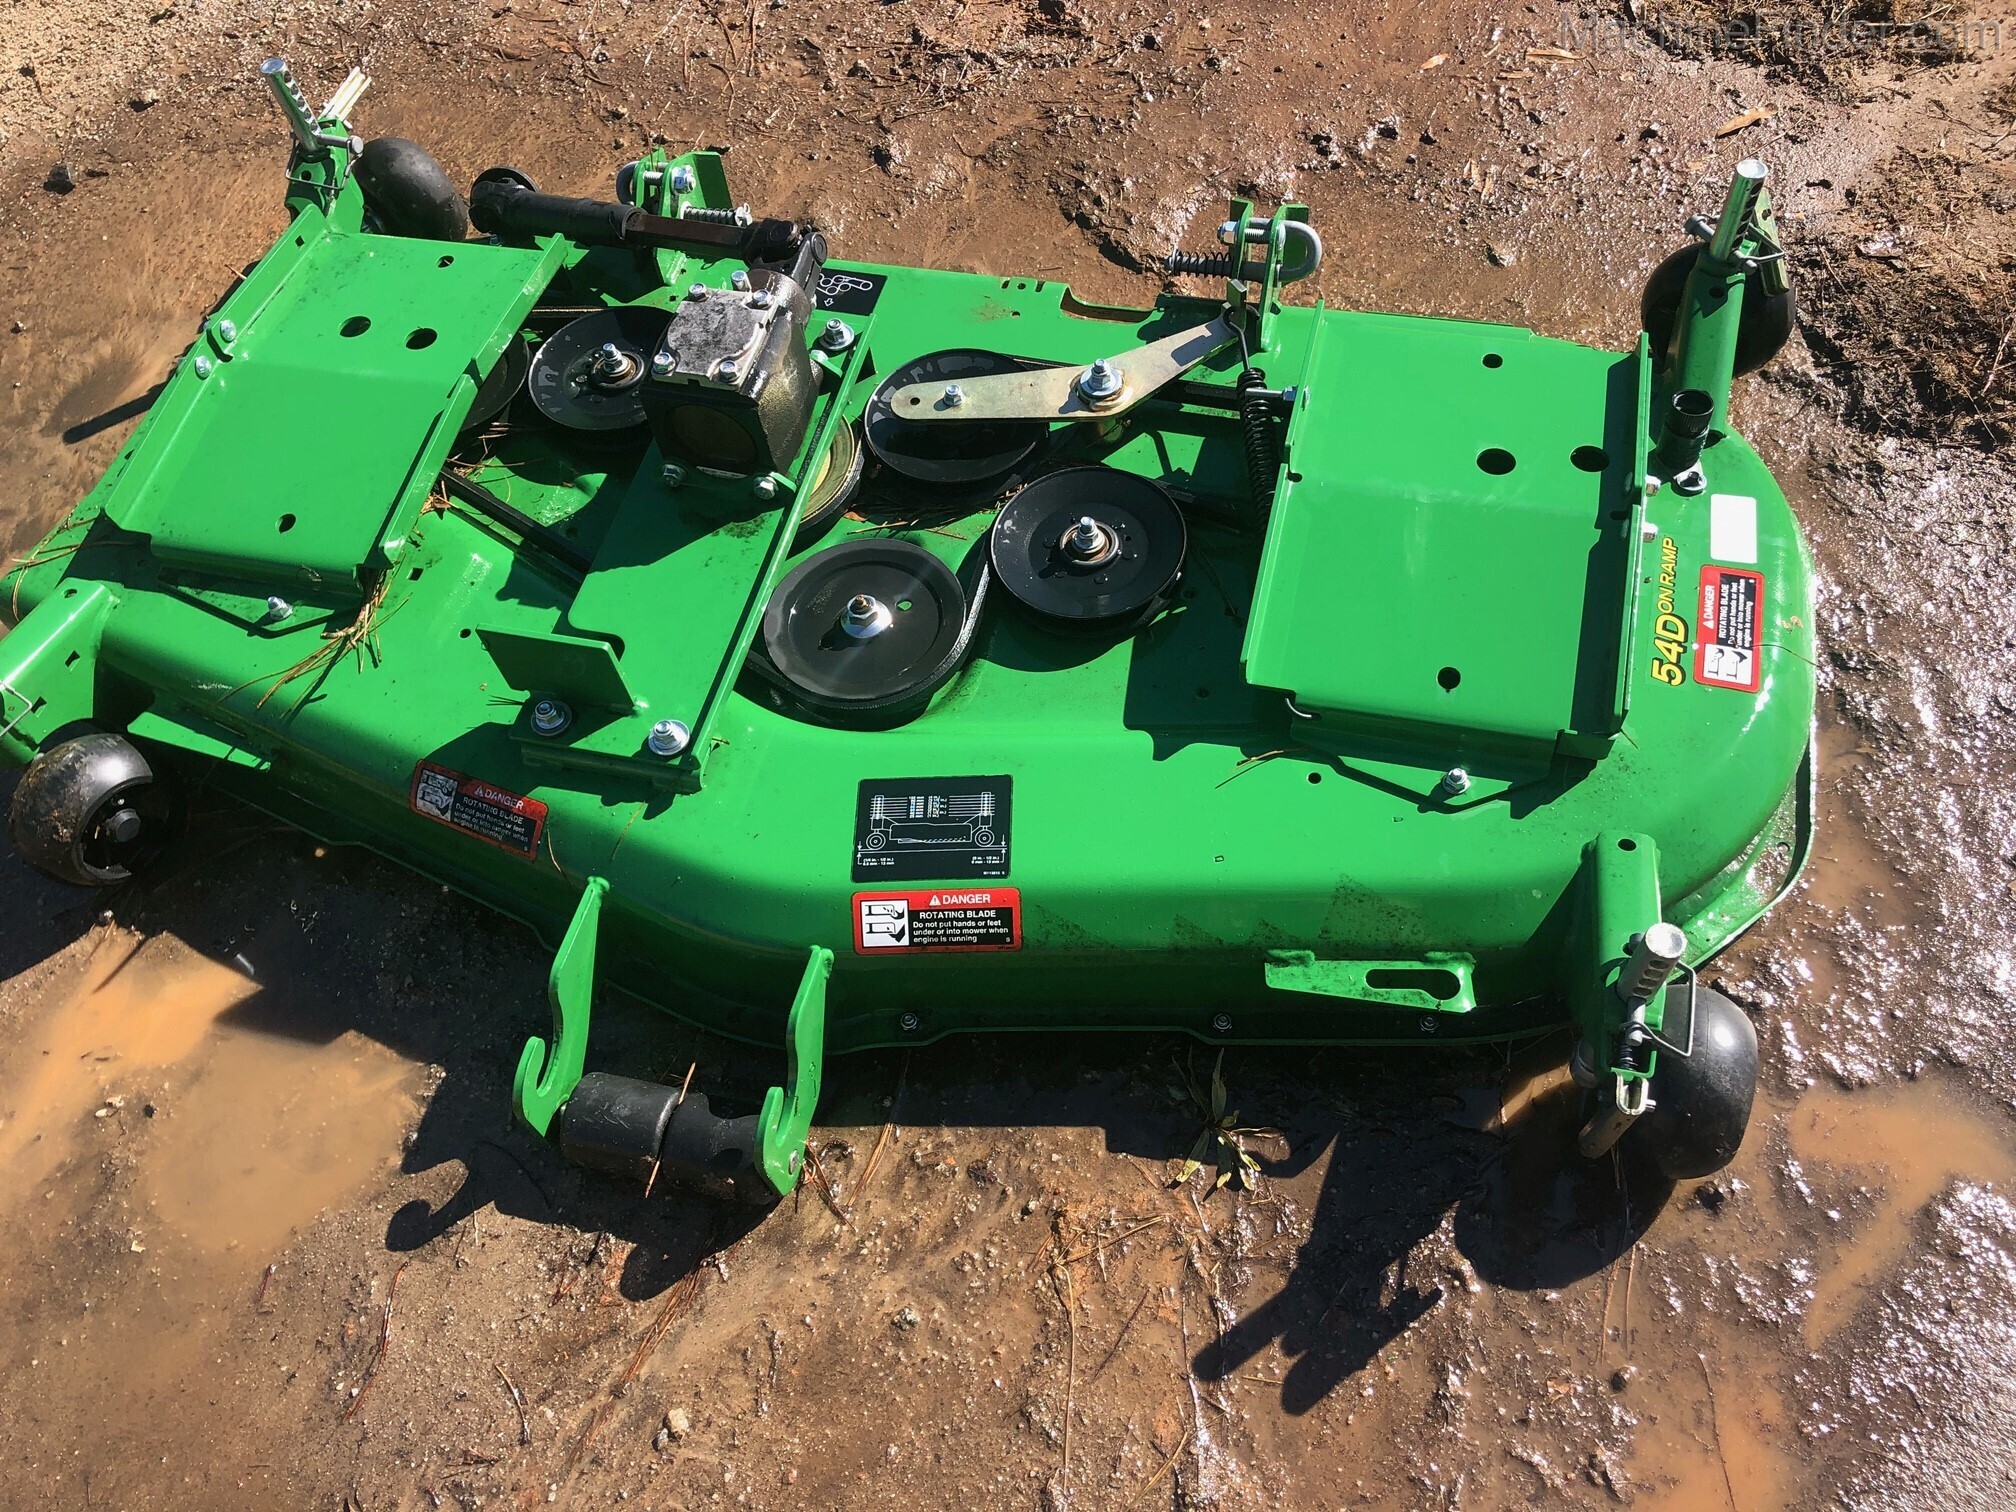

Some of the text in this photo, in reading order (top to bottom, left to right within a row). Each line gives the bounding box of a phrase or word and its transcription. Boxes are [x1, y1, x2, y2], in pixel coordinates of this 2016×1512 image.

[1703, 584, 1715, 620] DANGER
[1651, 537, 1688, 686] 54D ON RAMP
[1718, 583, 1730, 639] ROTATING BLADE
[484, 788, 524, 810] DANGER
[463, 796, 524, 825] ROTATING BLADE
[942, 893, 991, 905] DANGER
[919, 910, 997, 920] ROTATING BLADE
[913, 928, 935, 936] under
[946, 927, 961, 935] into
[988, 926, 1009, 934] when
[939, 920, 952, 929] put
[953, 919, 976, 927] hands
[987, 919, 1001, 927] feet
[913, 935, 939, 944] engine
[949, 934, 978, 943] running
